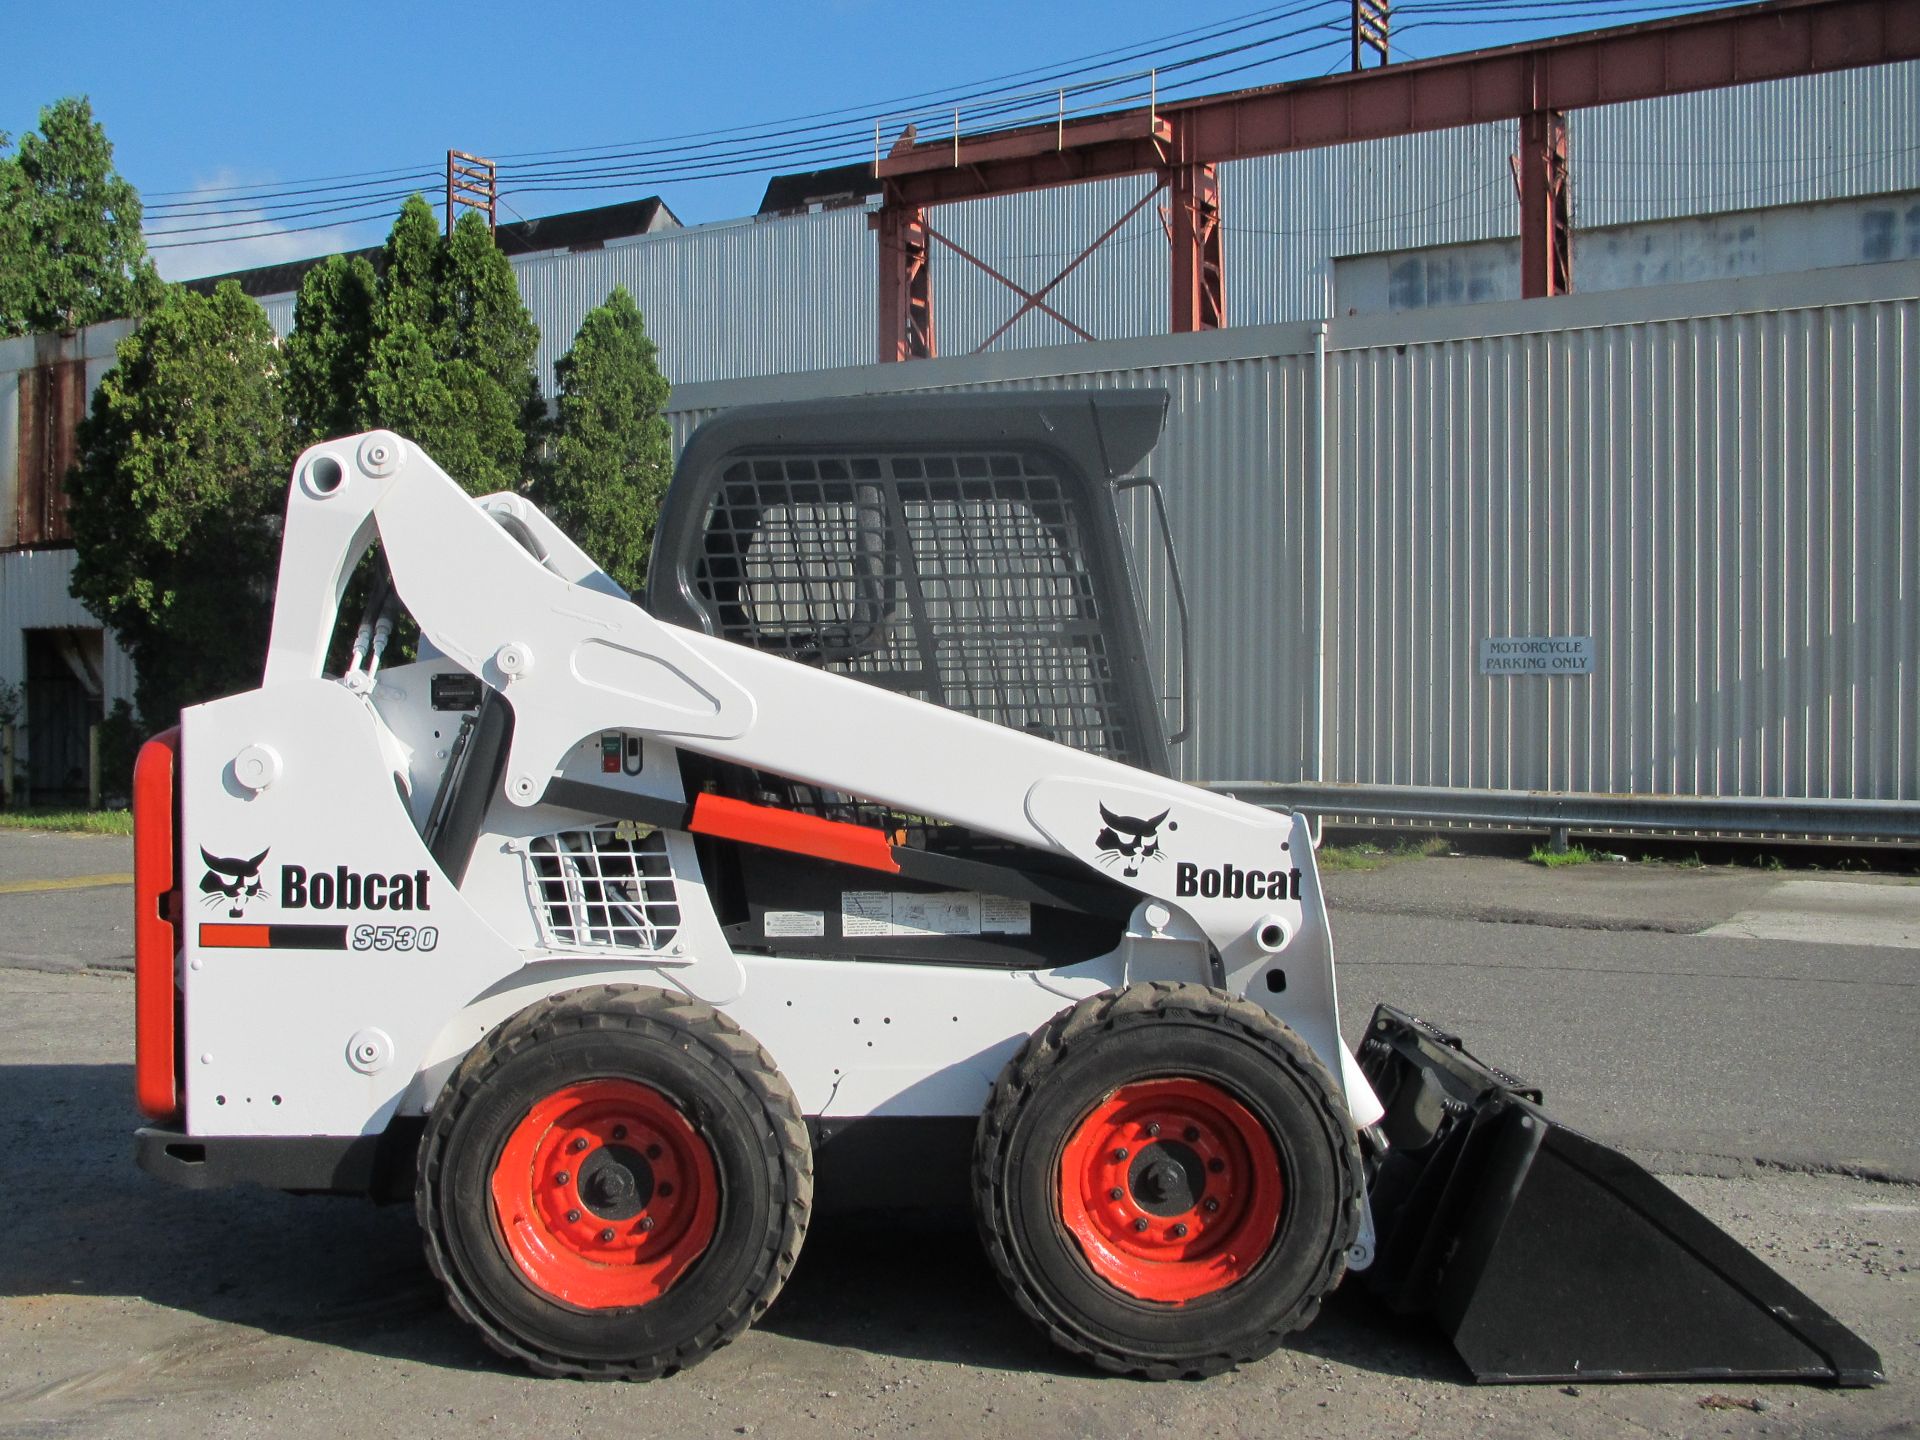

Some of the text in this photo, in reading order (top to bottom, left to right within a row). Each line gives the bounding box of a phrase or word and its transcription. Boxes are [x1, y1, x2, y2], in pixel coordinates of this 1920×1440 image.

[1490, 642, 1583, 653] MOTORCYCLE
[1486, 657, 1588, 669] PARKING ONLY
[281, 864, 431, 911] Bobcat
[1176, 862, 1302, 900] Bobcat
[352, 924, 439, 952] S530
